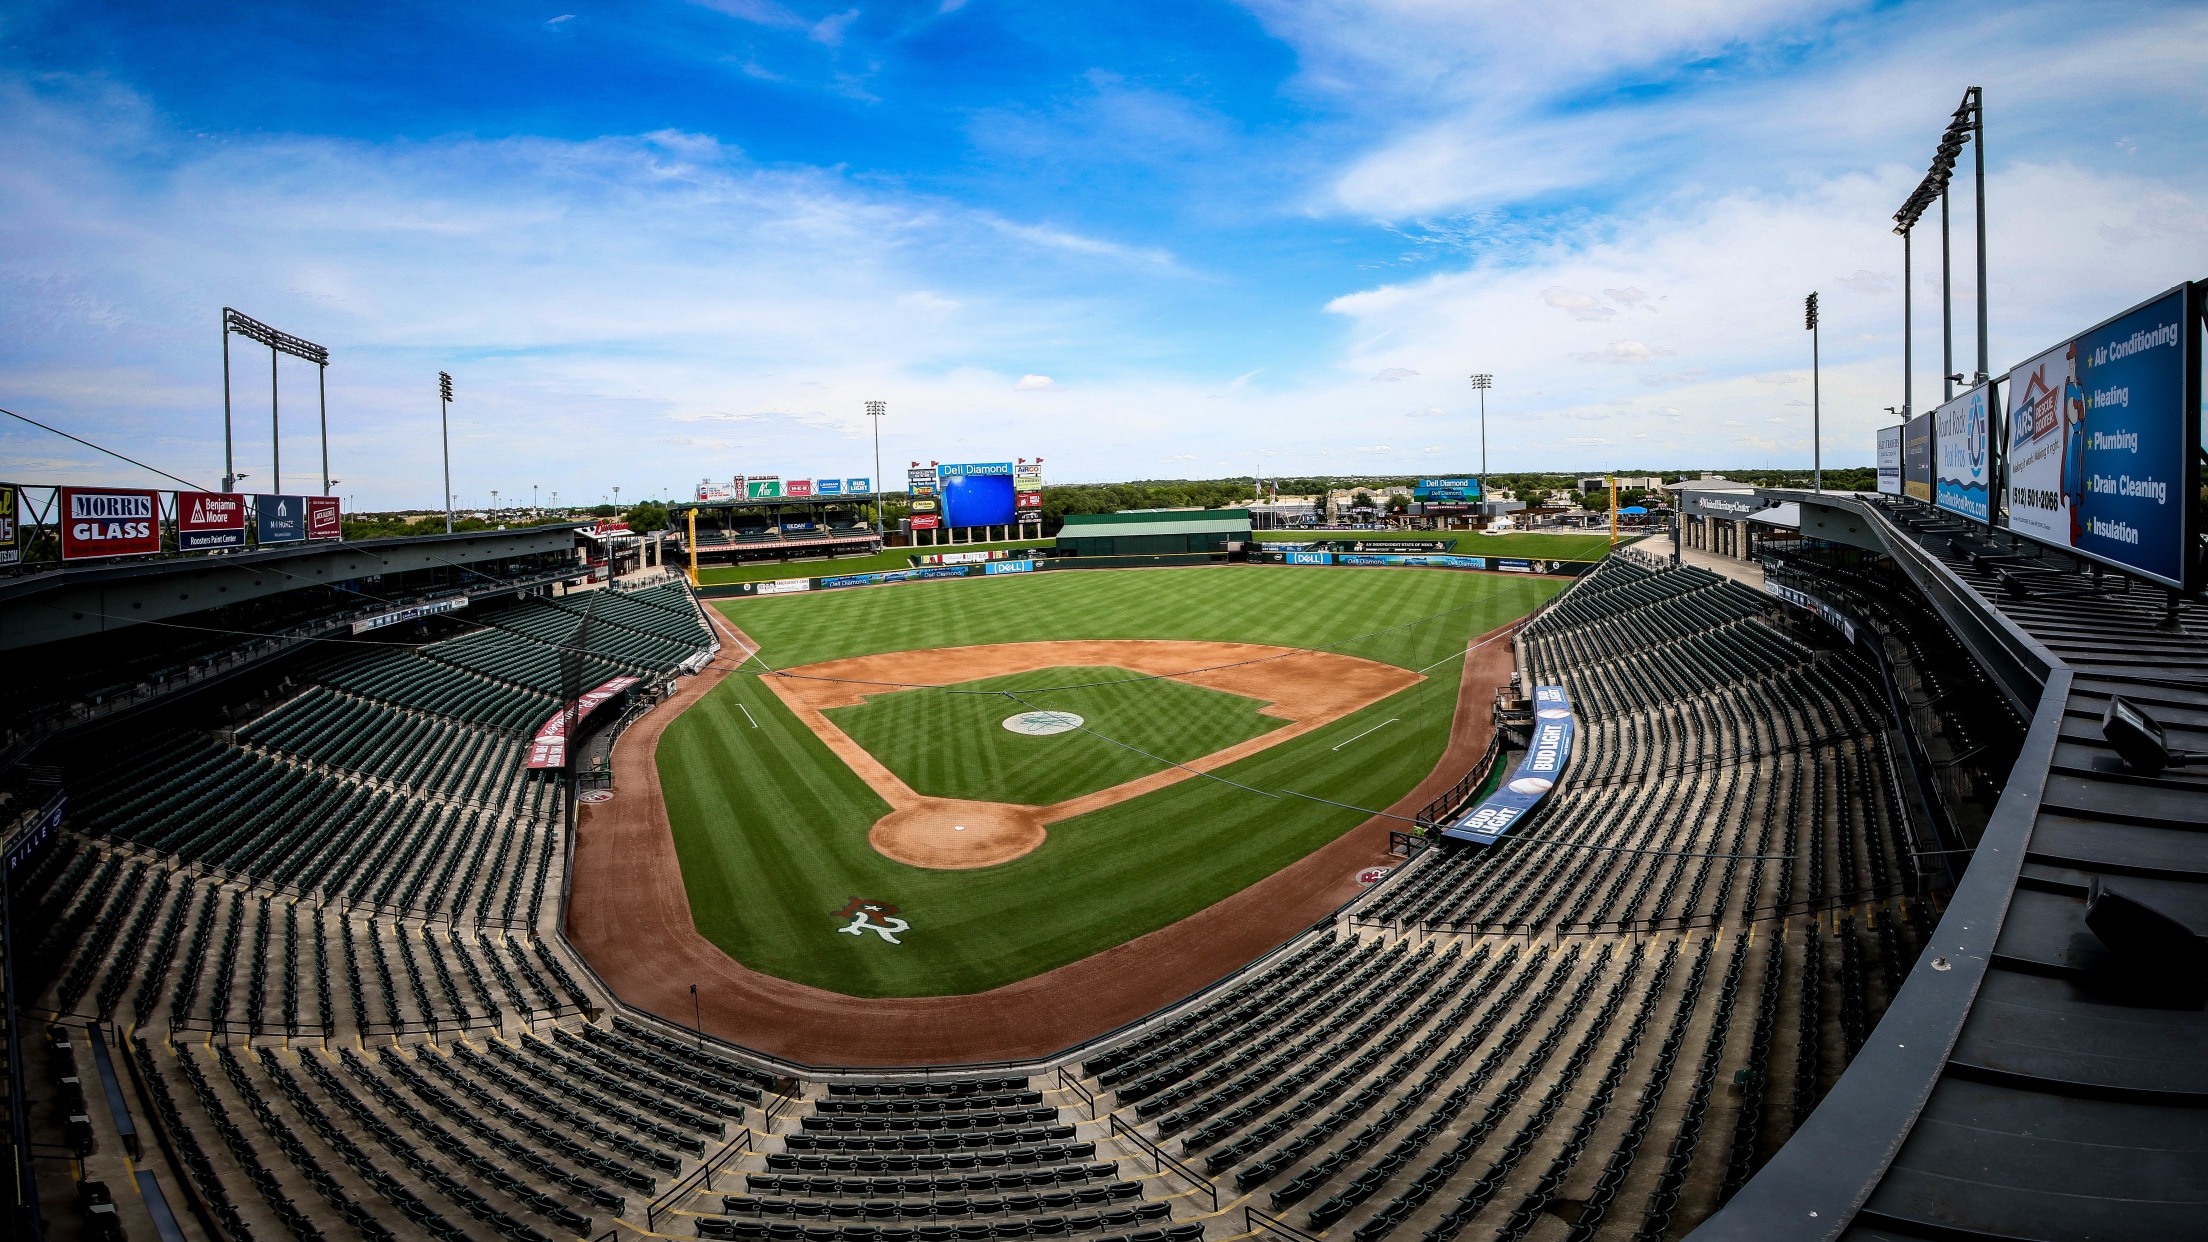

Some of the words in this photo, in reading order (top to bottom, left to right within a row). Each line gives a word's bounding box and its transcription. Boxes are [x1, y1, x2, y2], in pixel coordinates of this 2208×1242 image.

[2094, 348, 2108, 367] Air
[2109, 322, 2178, 362] Conditioning
[2094, 385, 2129, 409] Heating
[2016, 406, 2033, 441] ARS
[2094, 429, 2138, 453] Plumbing
[944, 465, 963, 475] Dell
[966, 464, 1008, 474] Diamond
[2012, 487, 2026, 508] (512)
[2027, 488, 2058, 512] 501-2066
[2093, 474, 2117, 495] Drain
[2119, 474, 2167, 505] Cleaning
[76, 497, 150, 517] MORRIS
[205, 498, 236, 511] Benjamin
[206, 511, 228, 523] Moore
[72, 522, 150, 541] GLASS
[190, 536, 210, 545] Roosters
[211, 535, 222, 544] Paint
[222, 535, 237, 543] Center
[2093, 516, 2139, 545] Insulation
[998, 563, 1022, 572] DELL
[1298, 555, 1320, 563] DELL
[842, 579, 867, 587] Diamond
[1539, 725, 1563, 750] LIGHT
[1532, 750, 1557, 771] BUD
[1464, 809, 1497, 829] BUD
[1477, 808, 1518, 835] LIGHT
